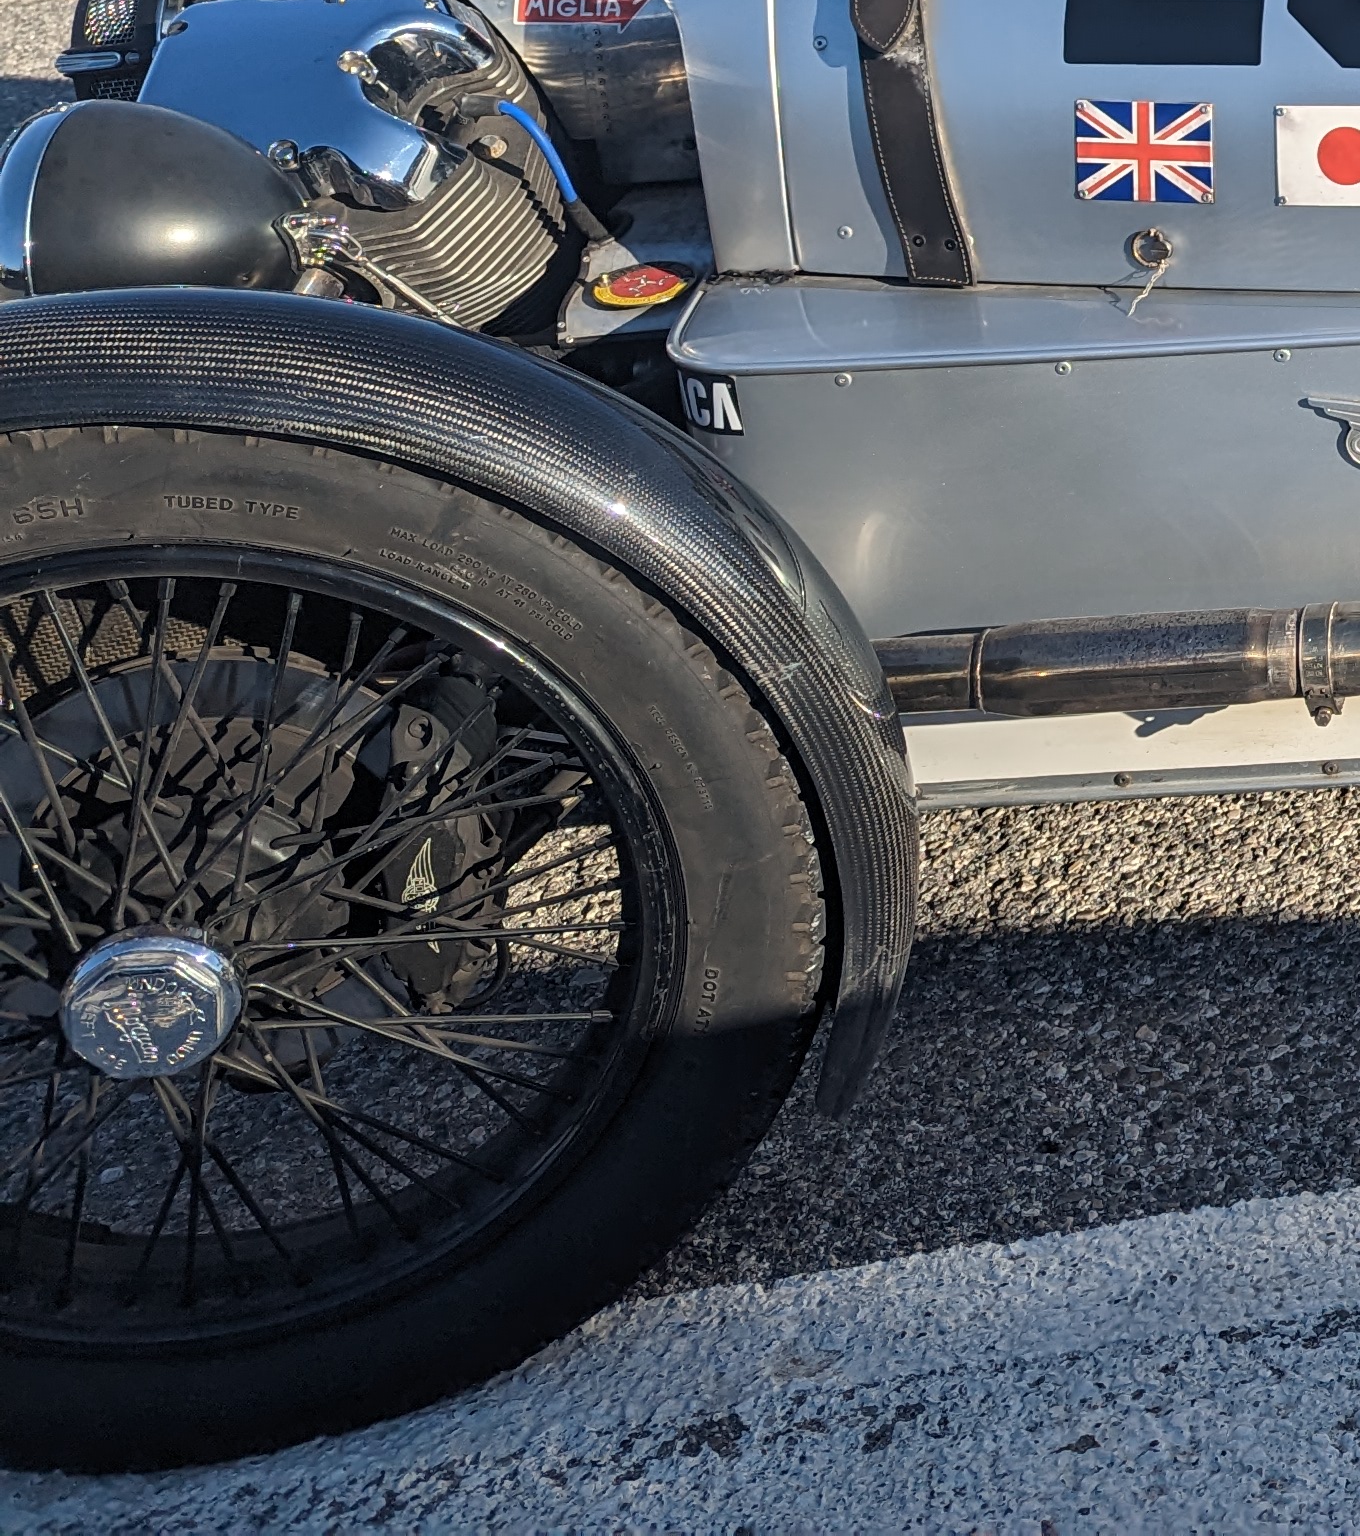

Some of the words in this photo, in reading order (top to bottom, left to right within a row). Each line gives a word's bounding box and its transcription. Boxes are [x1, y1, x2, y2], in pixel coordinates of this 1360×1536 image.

[12, 497, 84, 525] 65H
[163, 494, 234, 511] TUBED
[245, 499, 300, 520] TYPE
[378, 547, 412, 566] LOAD
[415, 561, 457, 586] RANGE
[390, 527, 417, 544] MAX
[421, 538, 454, 557] LOAD
[457, 553, 482, 570] 290
[499, 574, 515, 587] AT
[554, 608, 584, 633] COLD
[495, 588, 513, 600] AT
[545, 618, 574, 642] COLD
[702, 967, 720, 1003] DOT
